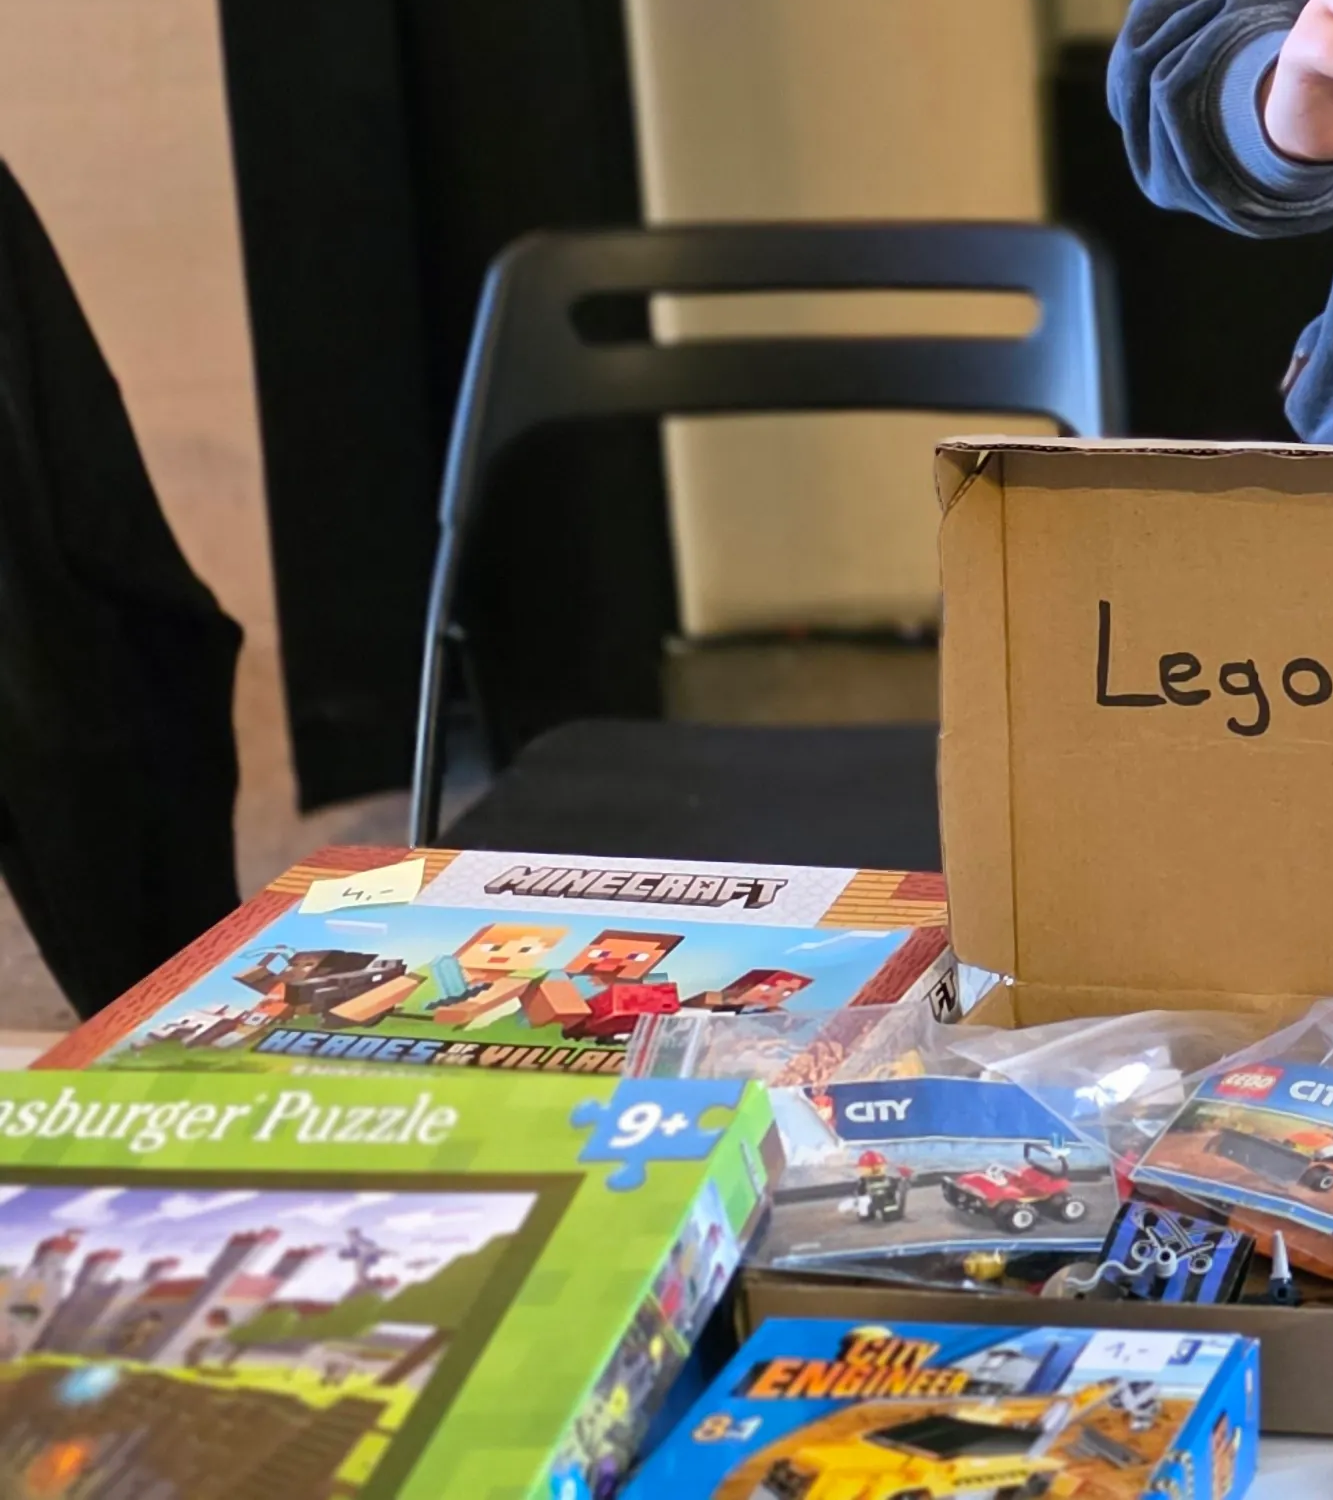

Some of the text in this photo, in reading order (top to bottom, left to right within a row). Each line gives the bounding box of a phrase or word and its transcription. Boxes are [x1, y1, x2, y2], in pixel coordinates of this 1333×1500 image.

[1097, 600, 1333, 736] Lego
[484, 865, 789, 908] MINECRAFT
[259, 1029, 444, 1065] HEROES
[1220, 1073, 1277, 1089] LEGO
[254, 1090, 458, 1145] Puzzle
[609, 1102, 690, 1148] 9+
[845, 1099, 913, 1122] CITY
[747, 1358, 972, 1398] ENGINEER
